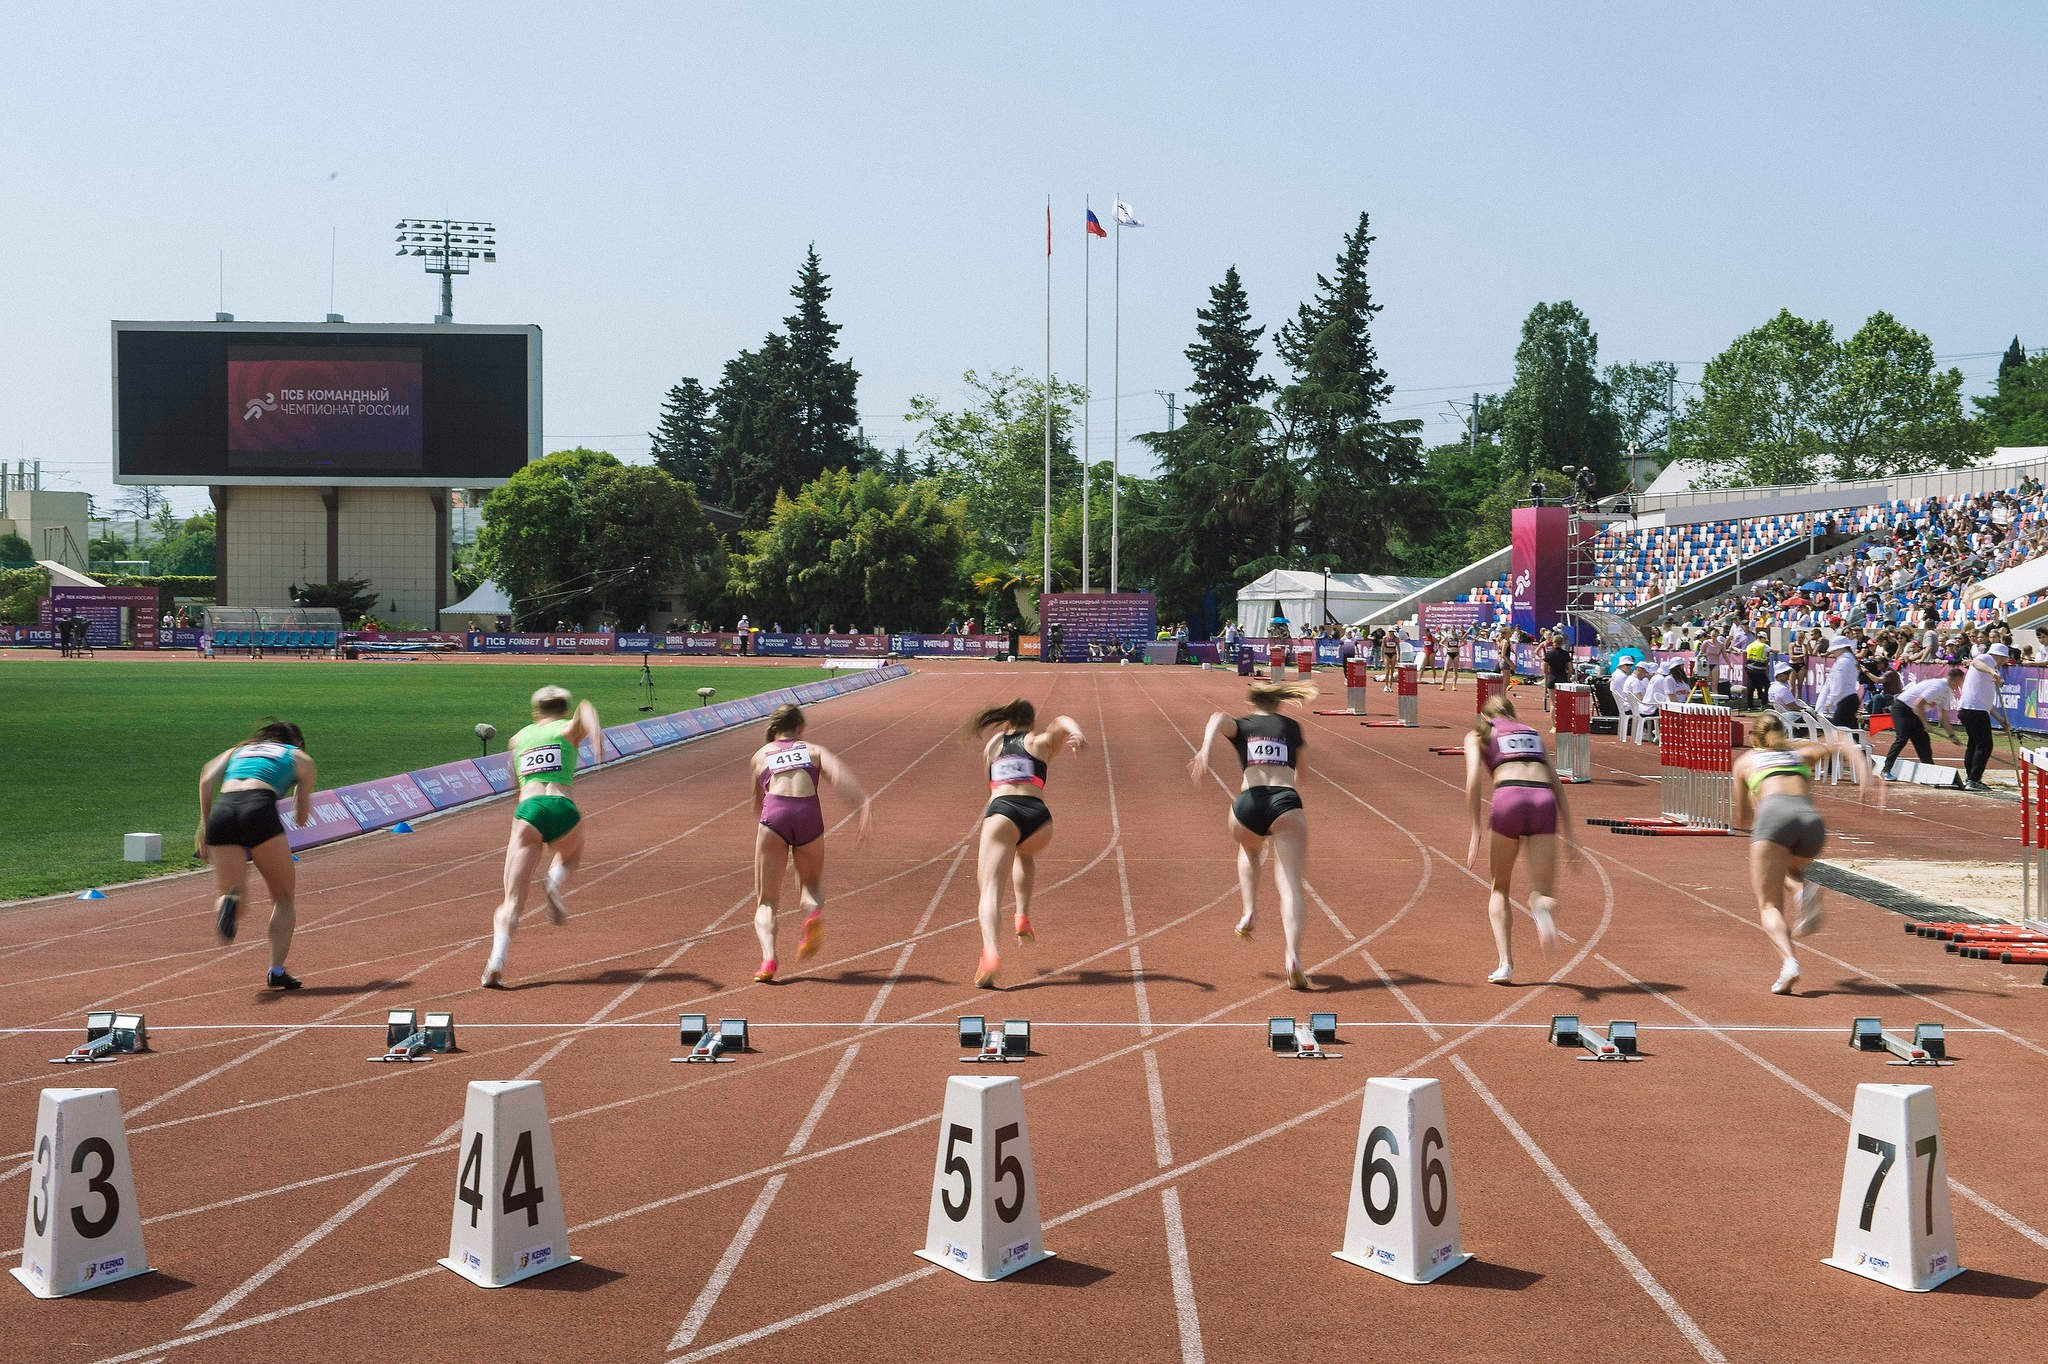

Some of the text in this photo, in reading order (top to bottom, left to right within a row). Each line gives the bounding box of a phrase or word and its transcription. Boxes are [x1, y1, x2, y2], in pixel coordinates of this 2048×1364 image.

[280, 387, 390, 402] ПСБ КОМАНДНЫЙ
[281, 403, 410, 416] ЧЕМПИОНАТ РОССИИ
[29, 630, 52, 639] ПСБ
[486, 637, 506, 646] ПСБ
[509, 638, 541, 646] FONBET
[557, 637, 576, 646] ПСБ
[579, 638, 610, 646] FONBET
[776, 752, 803, 764] 413
[1254, 744, 1282, 757] 491
[526, 752, 555, 767] 260
[459, 1131, 483, 1229] 4
[502, 1130, 544, 1228] 4
[941, 1123, 973, 1223] 5
[994, 1122, 1025, 1224] 5
[1361, 1125, 1400, 1226] 6
[1421, 1126, 1448, 1227] 6
[33, 1135, 51, 1237] 3
[70, 1136, 120, 1239] 3
[1857, 1133, 1896, 1232] 7
[1915, 1134, 1938, 1236] 7
[531, 1247, 551, 1260] KERKO
[1376, 1249, 1395, 1261] KERKO
[100, 1257, 124, 1270] KERKO
